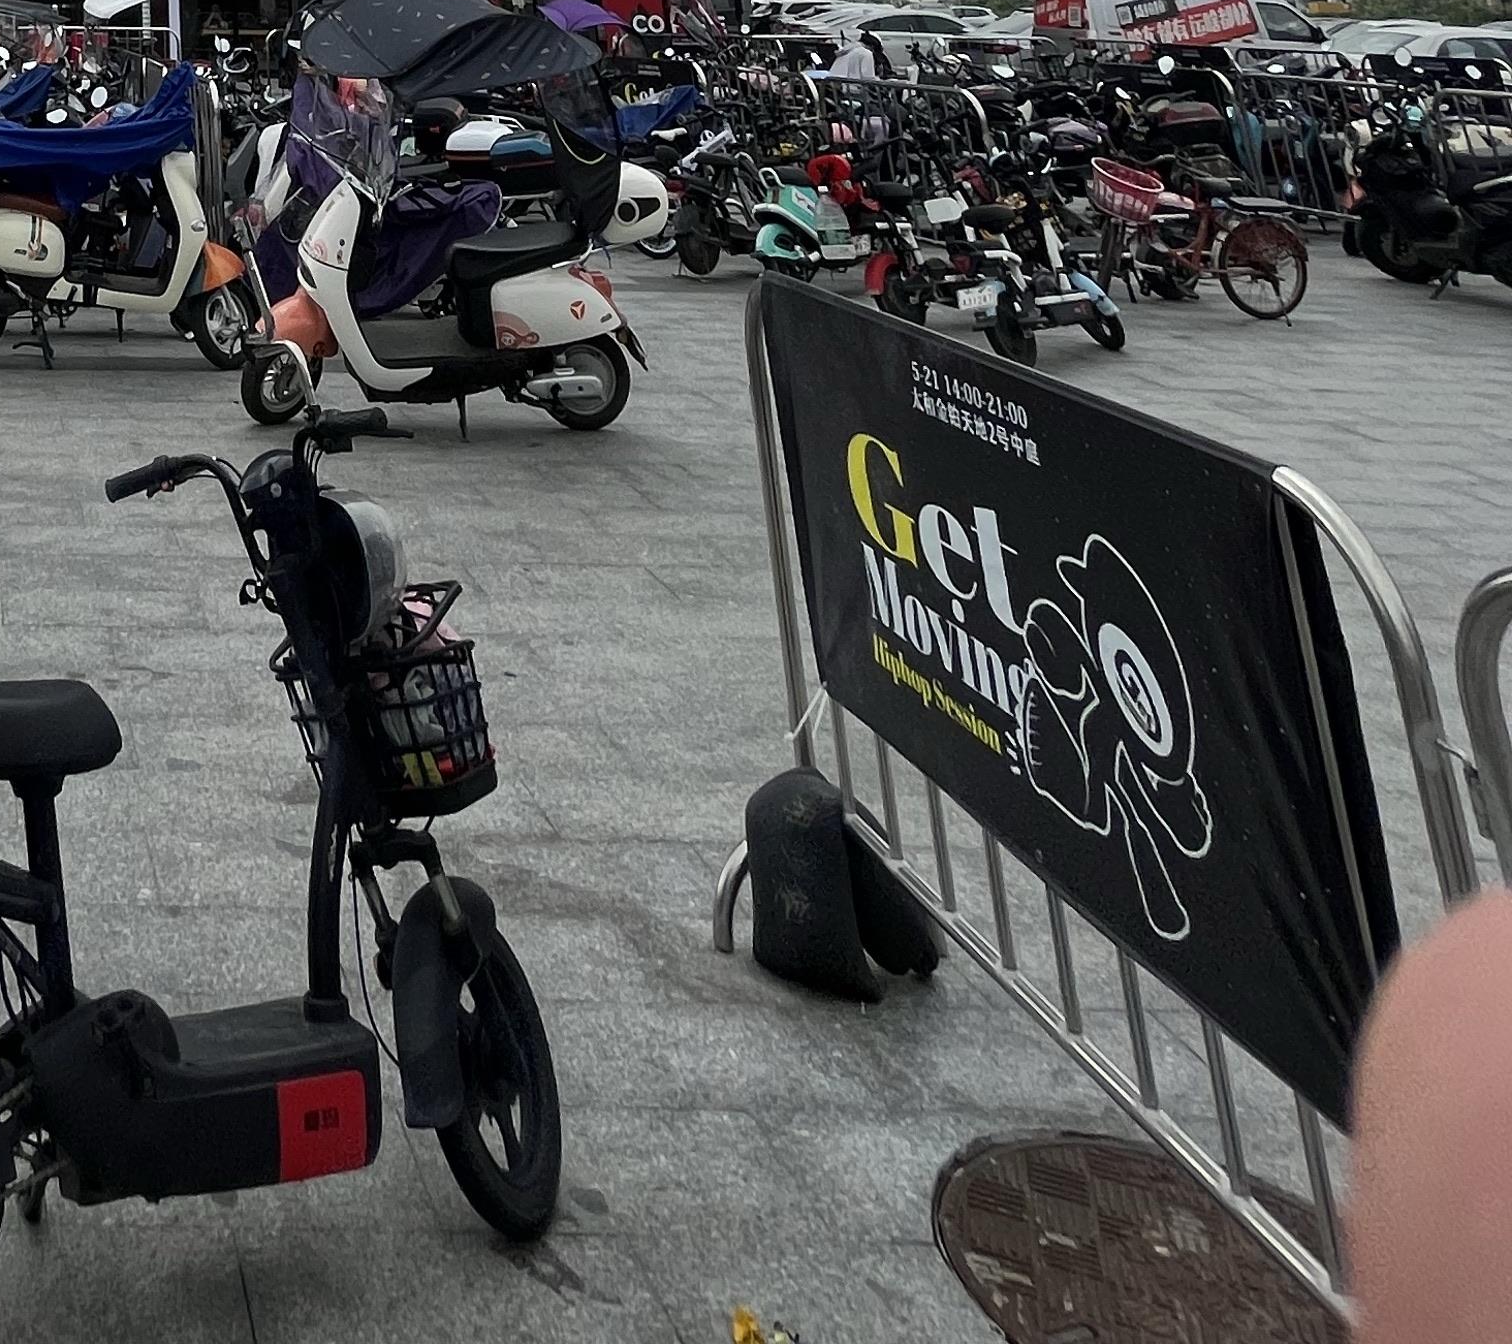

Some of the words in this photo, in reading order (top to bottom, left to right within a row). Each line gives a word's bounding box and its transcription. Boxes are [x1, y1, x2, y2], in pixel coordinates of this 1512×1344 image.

[911, 361, 939, 390] 5-21
[944, 375, 1028, 429] 14:00-21:00
[912, 386, 1041, 467] 太和金铂天地2号中庭
[847, 433, 1026, 636] Get
[861, 540, 1039, 750] Moving
[872, 633, 932, 709] Hiphop
[932, 678, 1003, 755] Session
